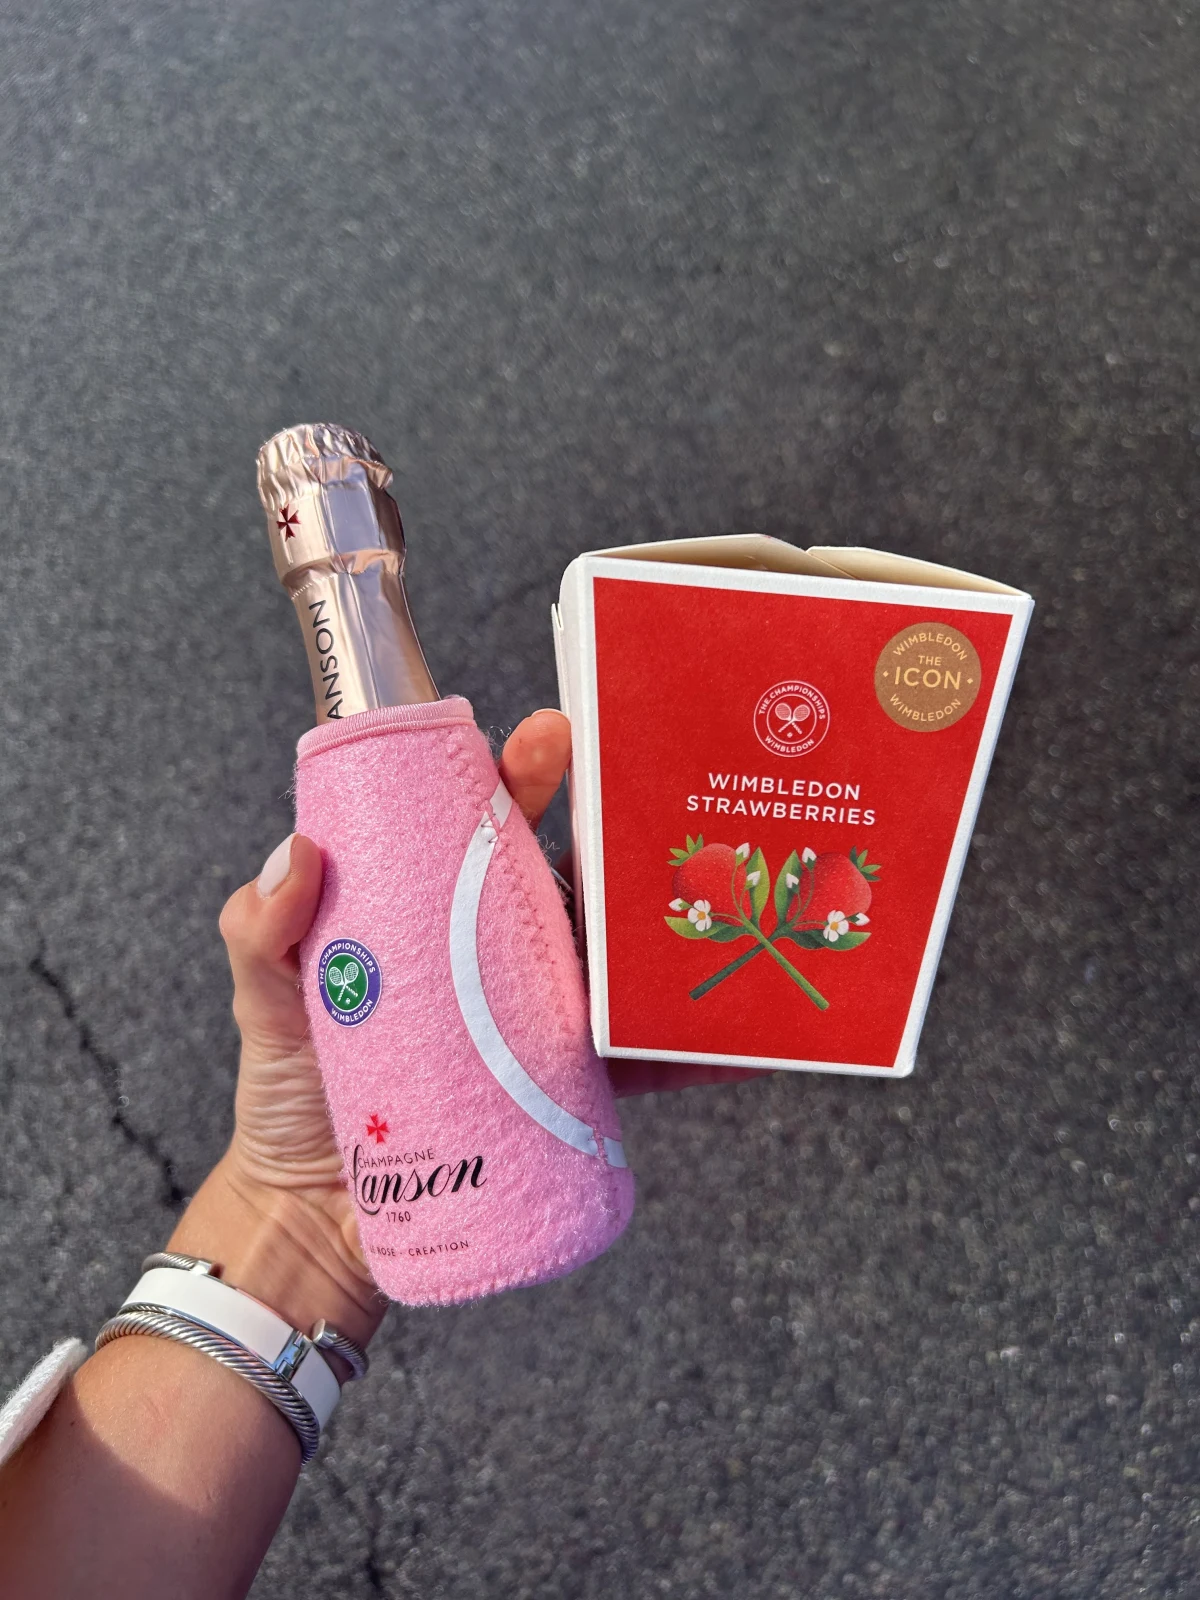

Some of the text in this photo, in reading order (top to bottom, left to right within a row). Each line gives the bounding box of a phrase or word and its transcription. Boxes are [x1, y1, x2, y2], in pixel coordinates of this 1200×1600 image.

[893, 632, 967, 661] WIMBLEDON
[918, 655, 942, 666] THE
[894, 666, 962, 690] ICON
[759, 685, 826, 720] THE CHAMPIONSHIPS
[889, 694, 962, 722] WIMBLEDON
[765, 735, 815, 753] WIMBLEDON
[708, 772, 861, 801] WIMBLEDON
[686, 795, 876, 826] STRAWBERRIES
[321, 942, 376, 974] CHAMPIONSHIPS
[331, 998, 374, 1023] WIMBLEDON
[357, 1148, 435, 1169] CHAMPAGNE
[386, 1210, 412, 1223] 1760
